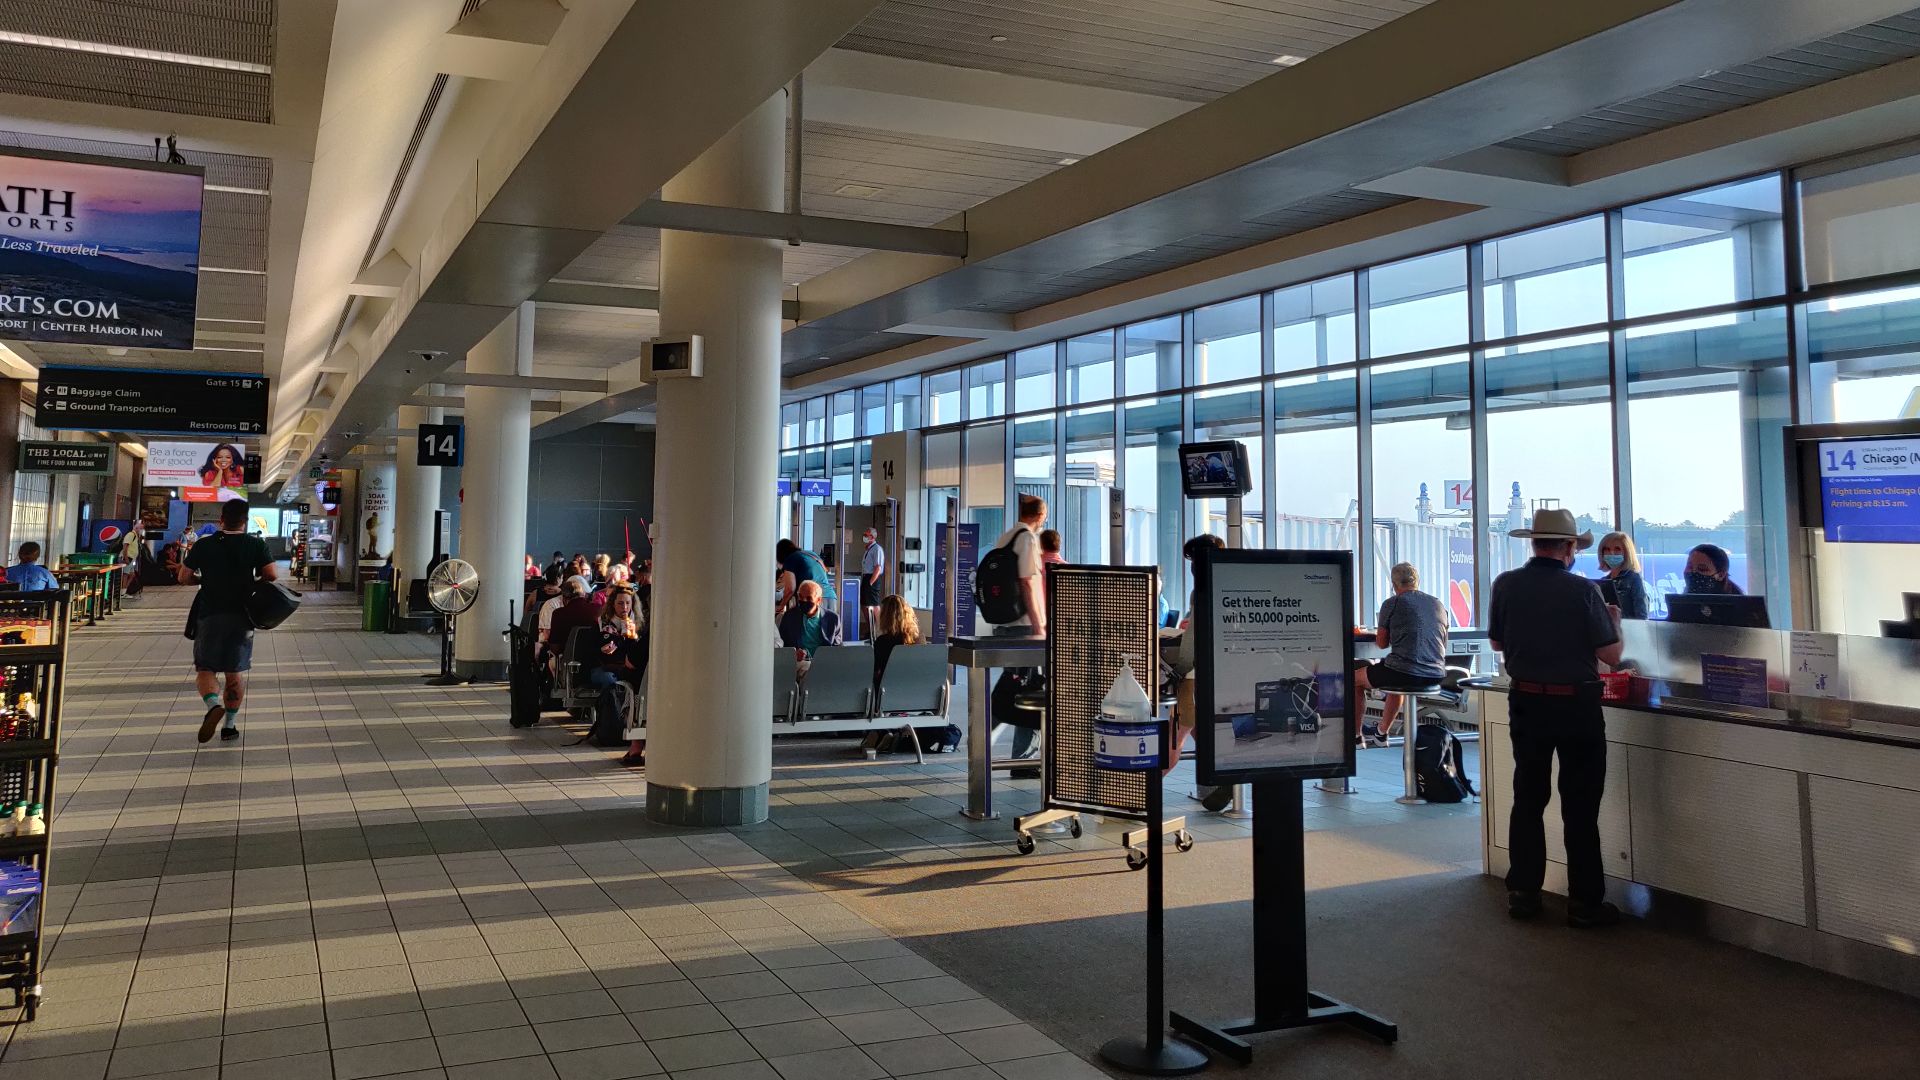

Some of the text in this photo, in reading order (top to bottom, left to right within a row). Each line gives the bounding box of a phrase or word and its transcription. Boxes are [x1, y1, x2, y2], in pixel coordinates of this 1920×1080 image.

[8, 216, 74, 232] ORTS
[1, 238, 99, 257] Less Traveled
[0, 294, 120, 320] RTS.COM
[41, 320, 86, 333] CENTER
[90, 324, 138, 336] HARBOR
[141, 327, 163, 337] INN
[206, 379, 227, 387] Gate
[70, 387, 141, 398] Baggage Claim
[70, 402, 177, 414] Ground Transportation
[190, 421, 237, 430] Restrooms
[423, 434, 456, 457] 14
[27, 448, 50, 457] THE
[53, 449, 87, 458] LOCAL
[149, 448, 162, 456] Be
[172, 448, 197, 457] force
[153, 457, 166, 465] for
[1826, 449, 1857, 471] 14
[1862, 454, 1907, 466] Chicago
[883, 460, 894, 481] 14
[1830, 487, 1853, 497] Flight
[1872, 487, 1882, 495] to
[1883, 486, 1916, 496] Chicago
[1831, 500, 1862, 509] Arriving
[1222, 596, 1302, 608] Get there faster
[1222, 611, 1320, 625] with 50,000 points.
[1300, 723, 1315, 731] VISA
